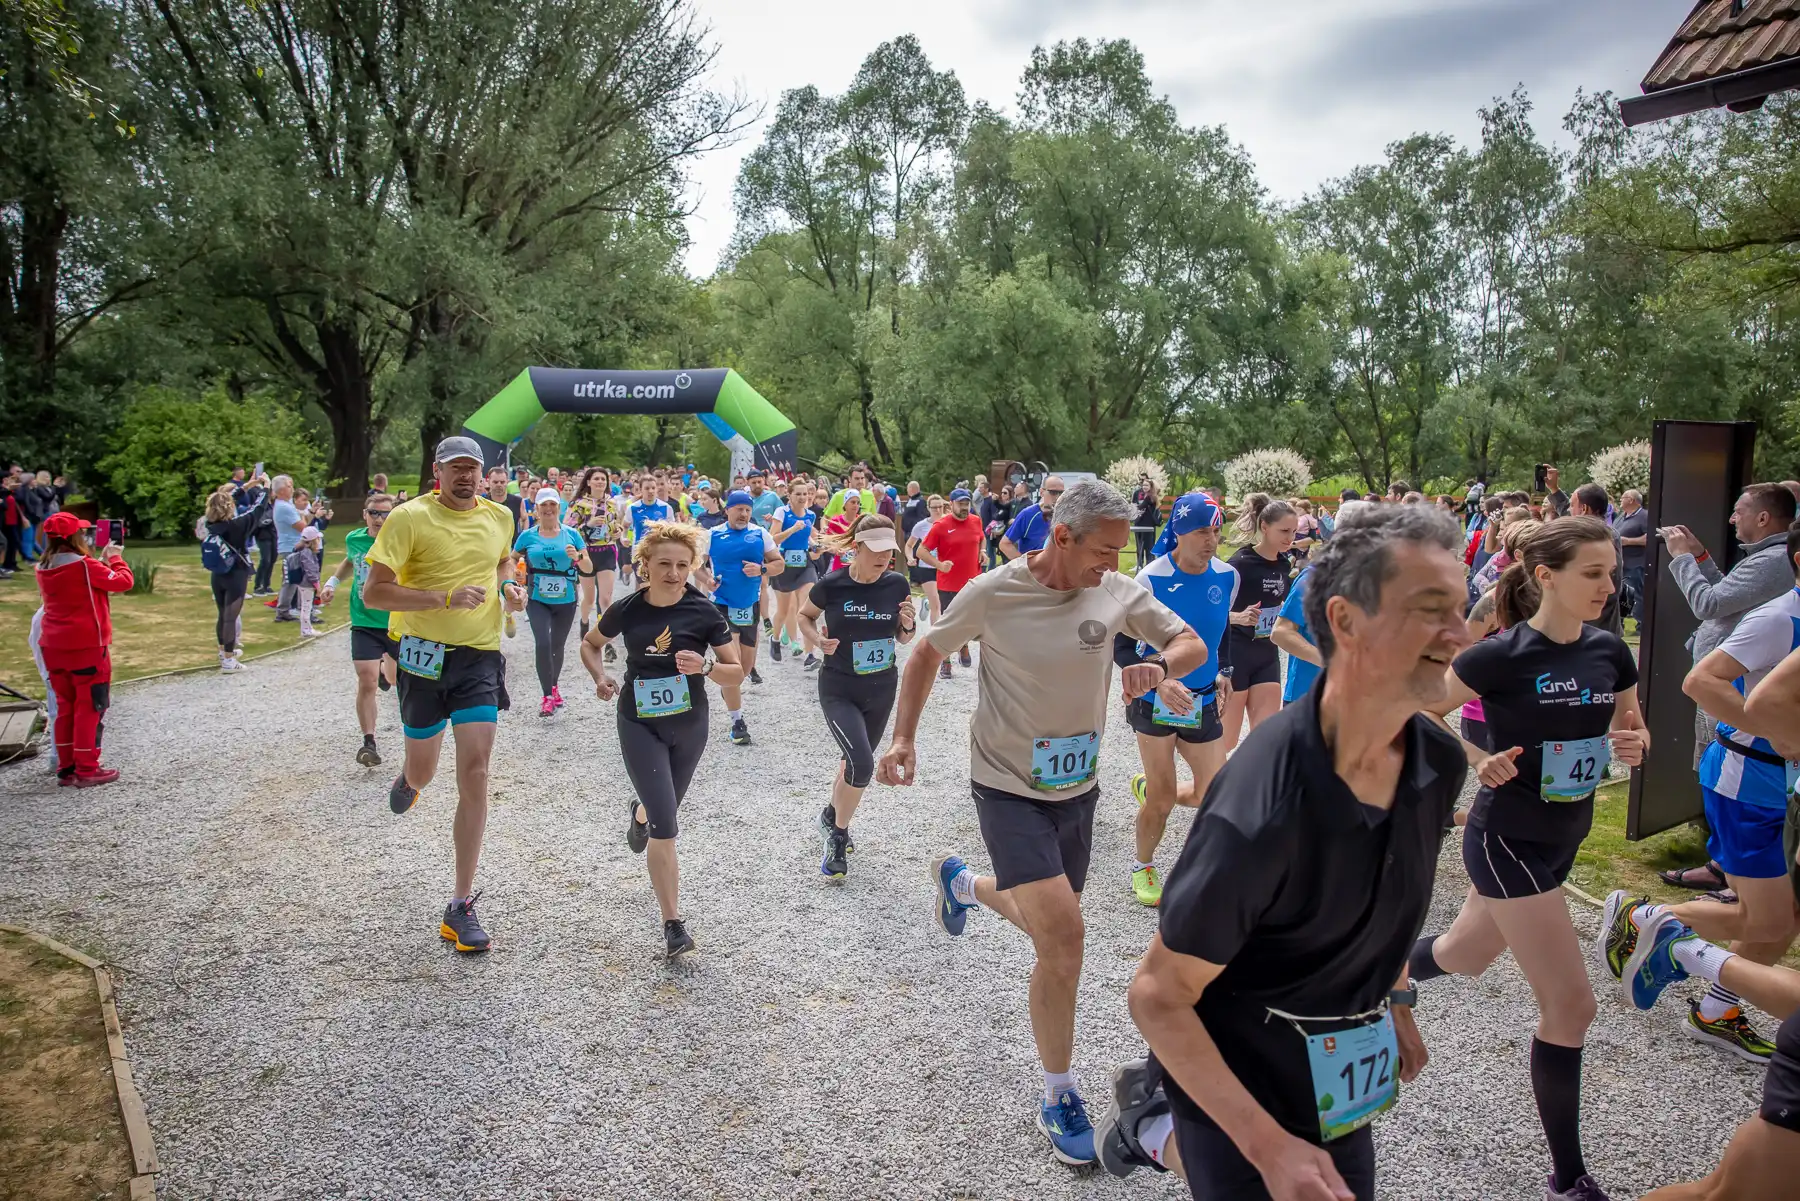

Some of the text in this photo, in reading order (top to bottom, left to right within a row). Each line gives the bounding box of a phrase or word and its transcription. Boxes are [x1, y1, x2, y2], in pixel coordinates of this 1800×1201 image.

[573, 380, 675, 398] utrka.com
[791, 554, 802, 562] 58
[547, 582, 560, 592] 26
[843, 600, 867, 612] Fund
[736, 610, 749, 620] 56
[1262, 615, 1277, 629] 14
[405, 647, 434, 667] 117
[866, 649, 884, 664] 43
[1535, 672, 1578, 695] Fund
[651, 689, 673, 705] 50
[1047, 749, 1087, 775] 101
[1568, 756, 1596, 783] 42
[1340, 1047, 1389, 1101] 172
